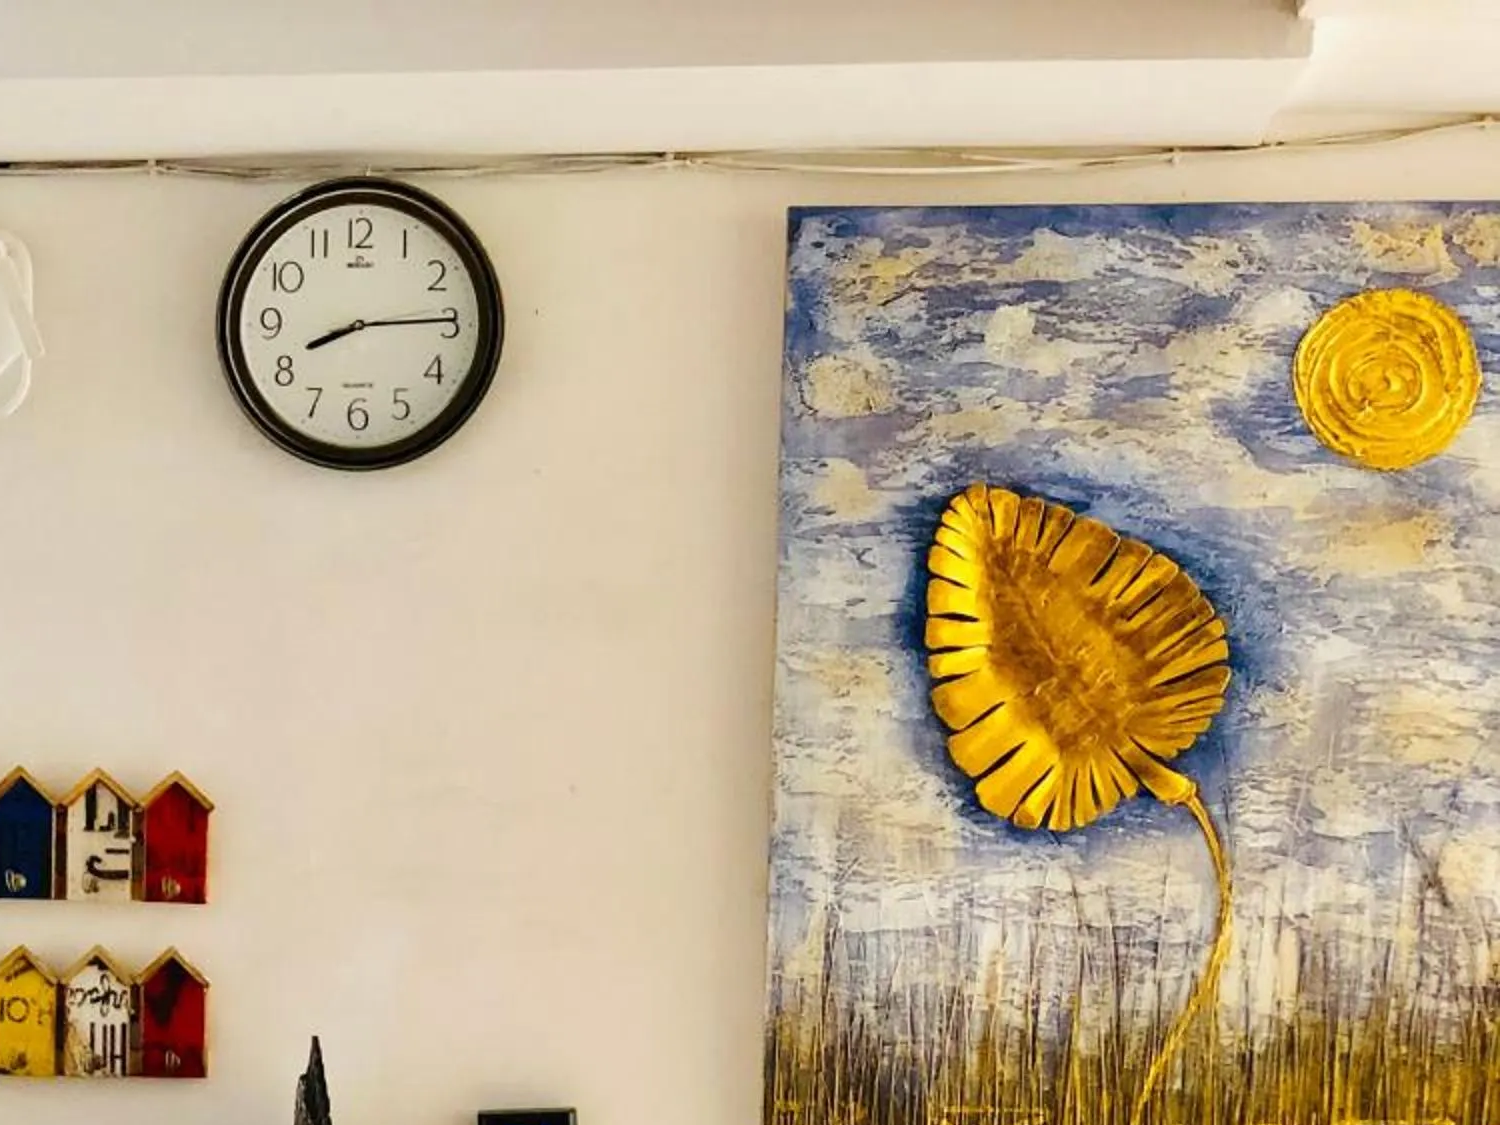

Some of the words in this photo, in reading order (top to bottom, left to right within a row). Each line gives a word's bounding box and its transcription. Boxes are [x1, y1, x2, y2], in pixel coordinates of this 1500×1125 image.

[311, 229, 328, 259] 11
[348, 217, 373, 249] 12
[402, 229, 408, 259] 1
[272, 261, 304, 293] 10
[427, 260, 447, 291] 2
[260, 307, 282, 340] 9
[440, 307, 460, 339] 3
[275, 355, 294, 386] 8
[423, 354, 444, 385] 4
[306, 387, 323, 418] 7
[347, 398, 369, 431] 6
[392, 388, 410, 420] 5
